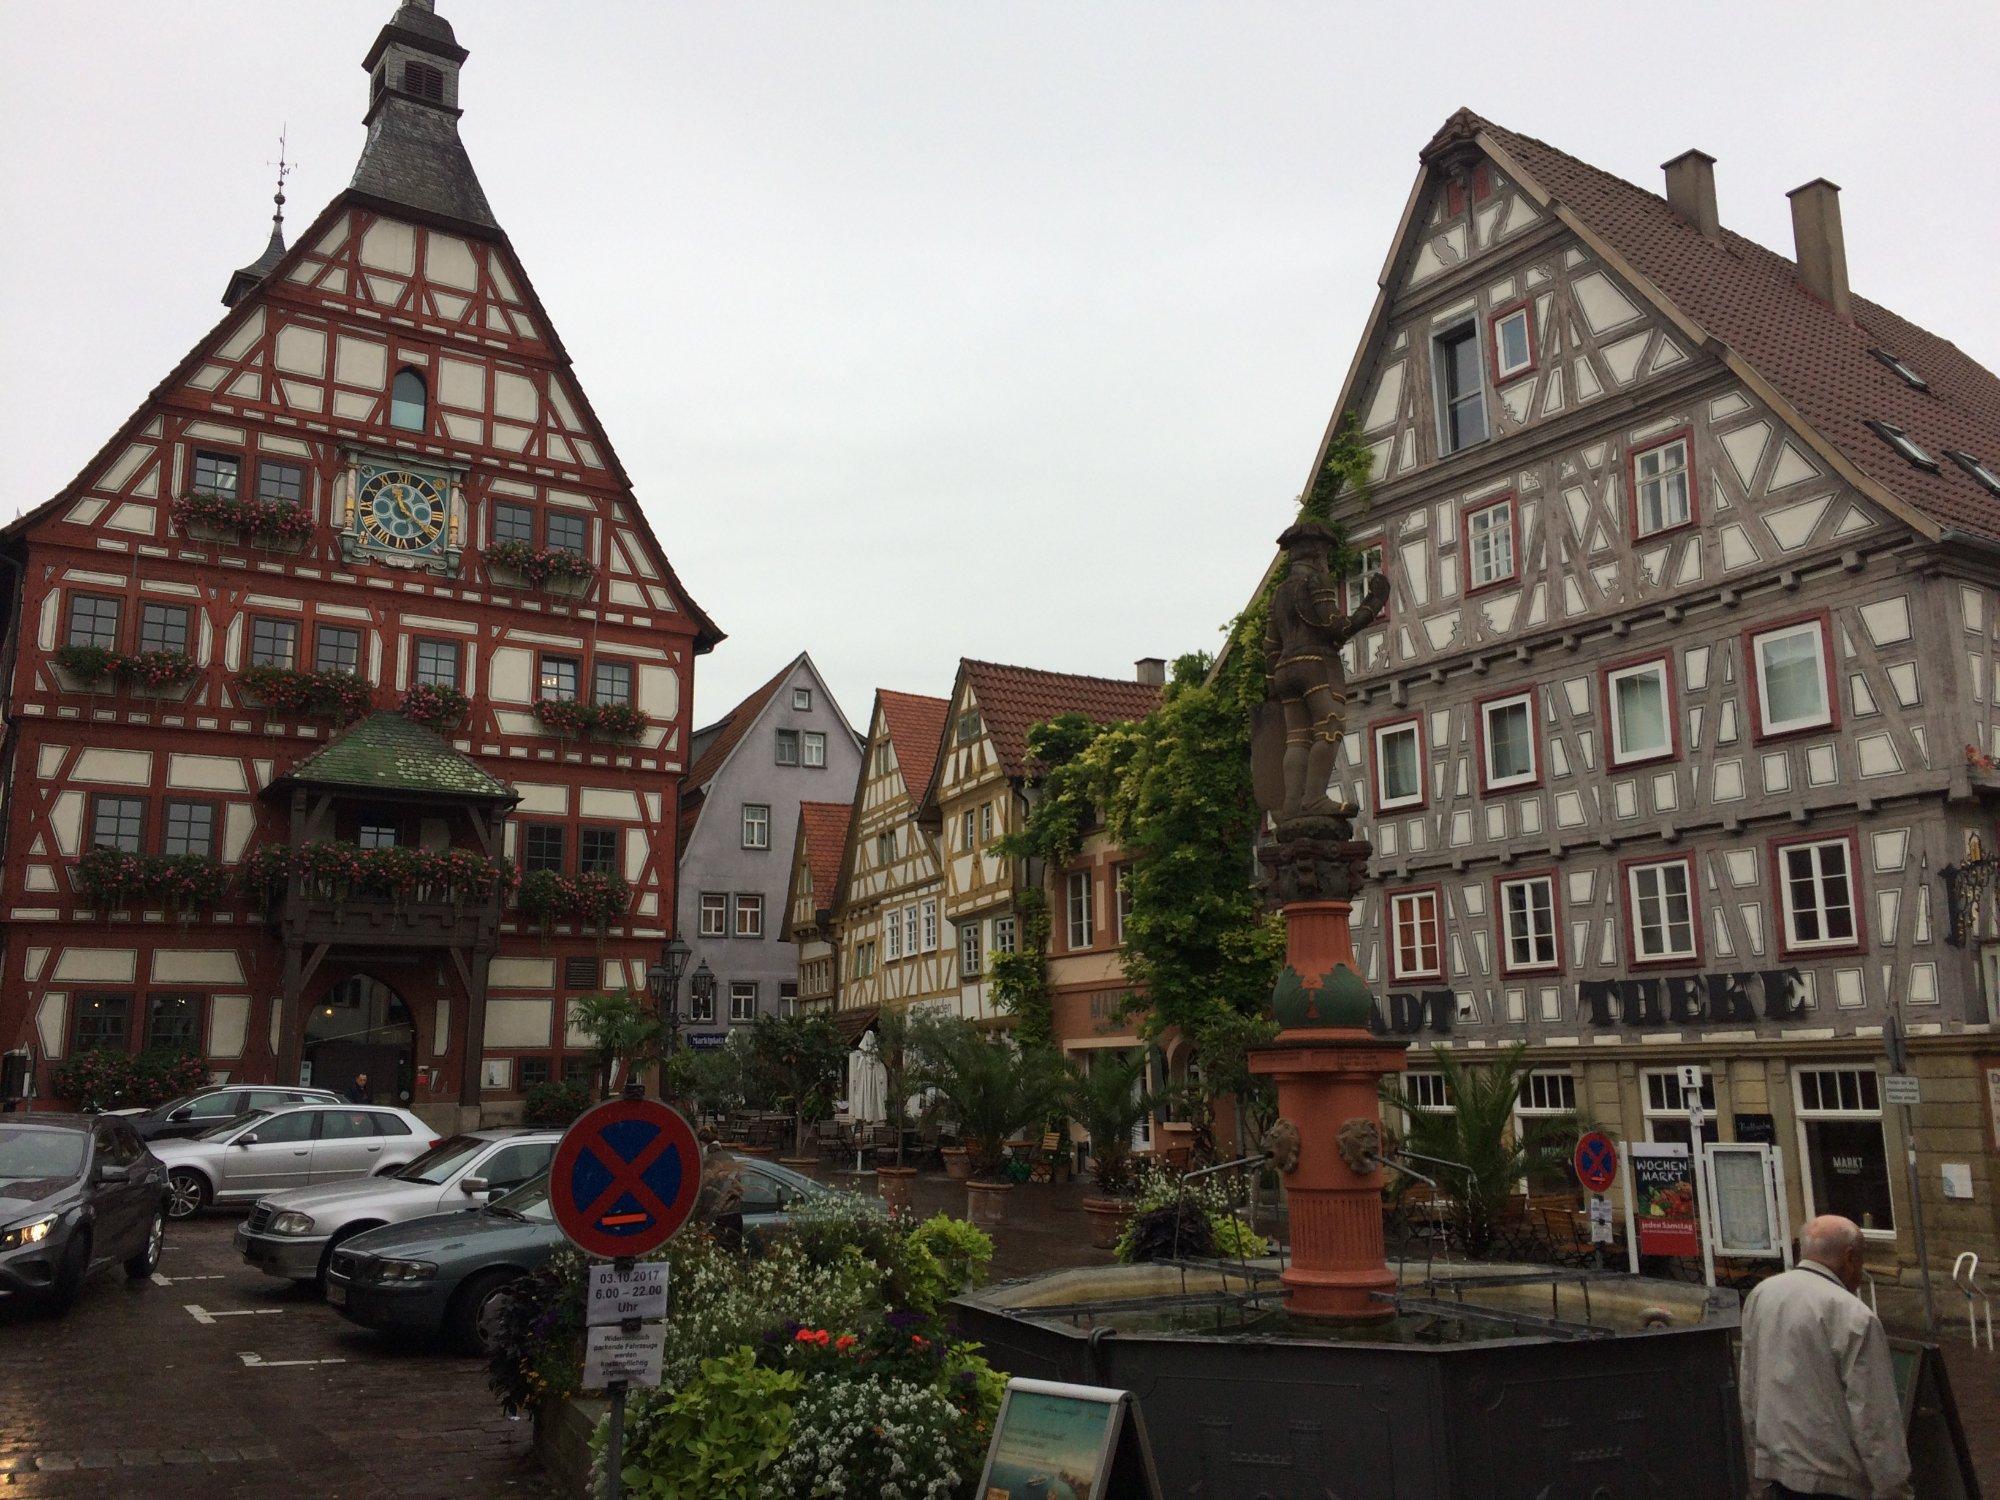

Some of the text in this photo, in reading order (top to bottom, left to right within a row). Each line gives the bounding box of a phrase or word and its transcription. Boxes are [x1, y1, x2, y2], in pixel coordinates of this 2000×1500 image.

[1580, 967, 1805, 1028] THEKE
[1636, 1160, 1688, 1172] WOCHEN
[1833, 1156, 1863, 1169] MARKT
[1641, 1171, 1683, 1183] MARKT
[600, 1271, 659, 1284] 03.10.2017
[595, 1288, 619, 1300] 6.00
[632, 1285, 662, 1297] 22.00
[617, 1302, 638, 1313] Uhr
